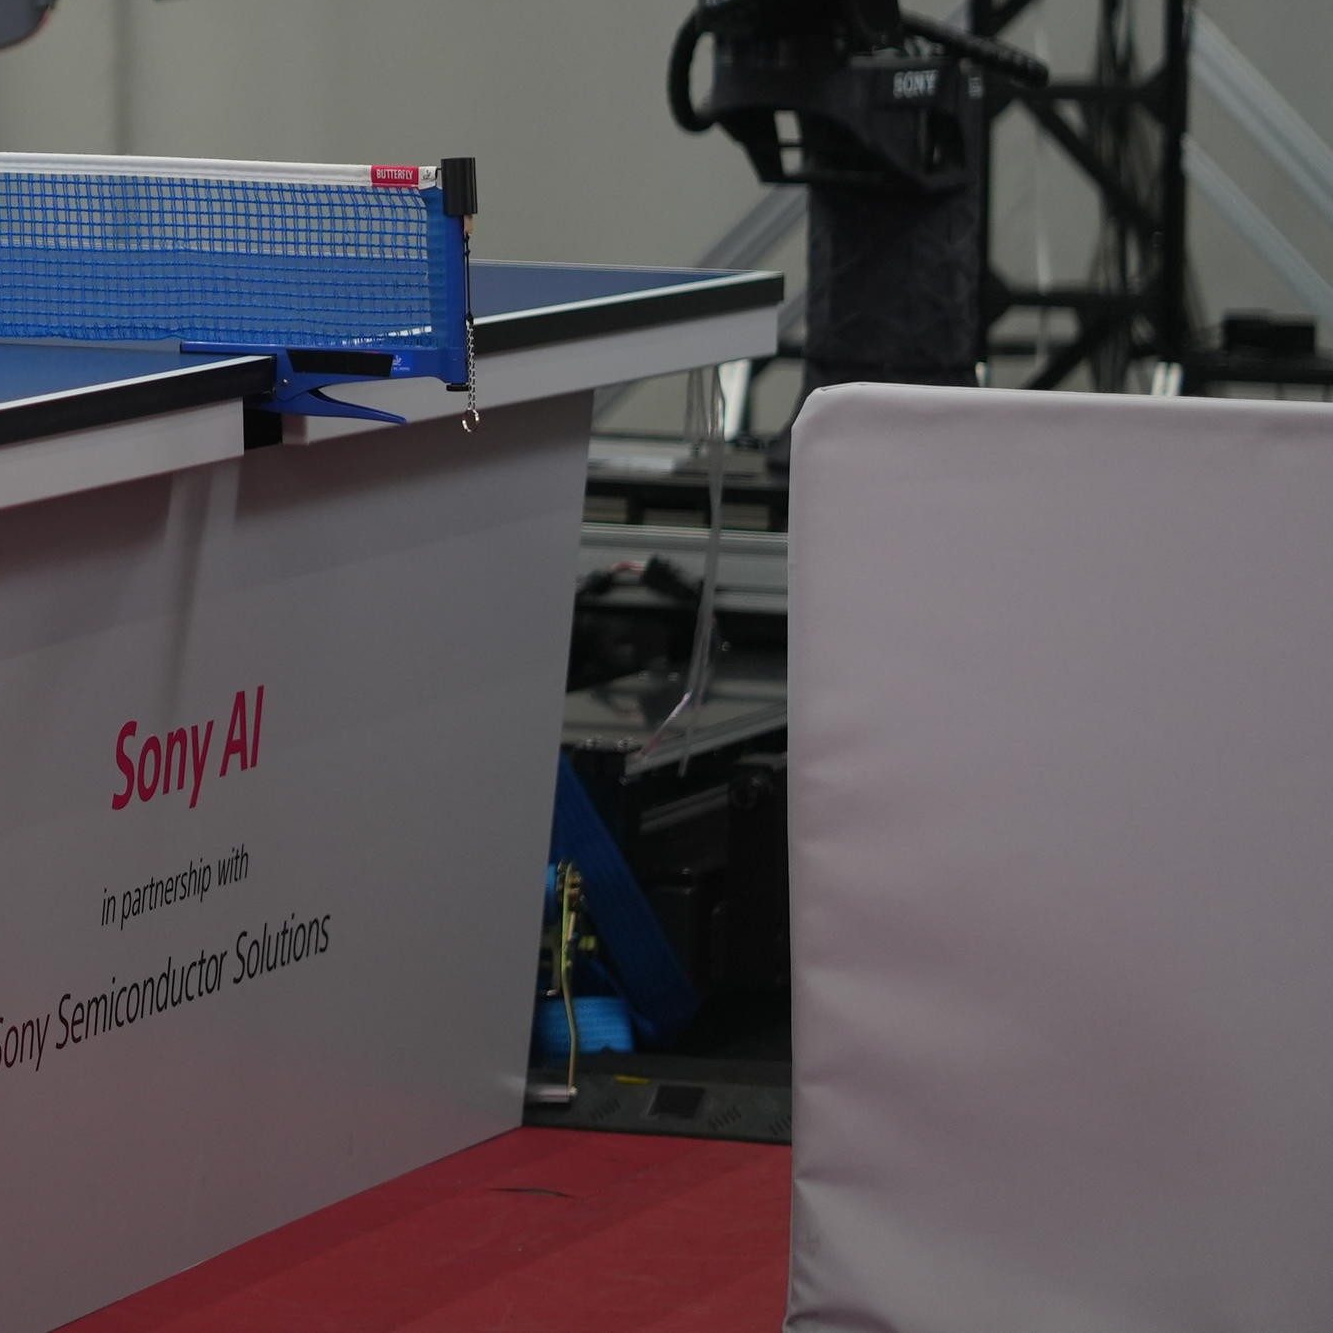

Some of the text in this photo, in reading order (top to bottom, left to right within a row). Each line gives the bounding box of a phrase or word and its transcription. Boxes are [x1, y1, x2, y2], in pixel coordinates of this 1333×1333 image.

[376, 169, 413, 180] BUTTERFLY
[112, 685, 265, 811] Sony AI
[101, 843, 250, 931] in partnership with
[55, 949, 228, 1050] Semiconductor
[232, 913, 331, 985] Solutions
